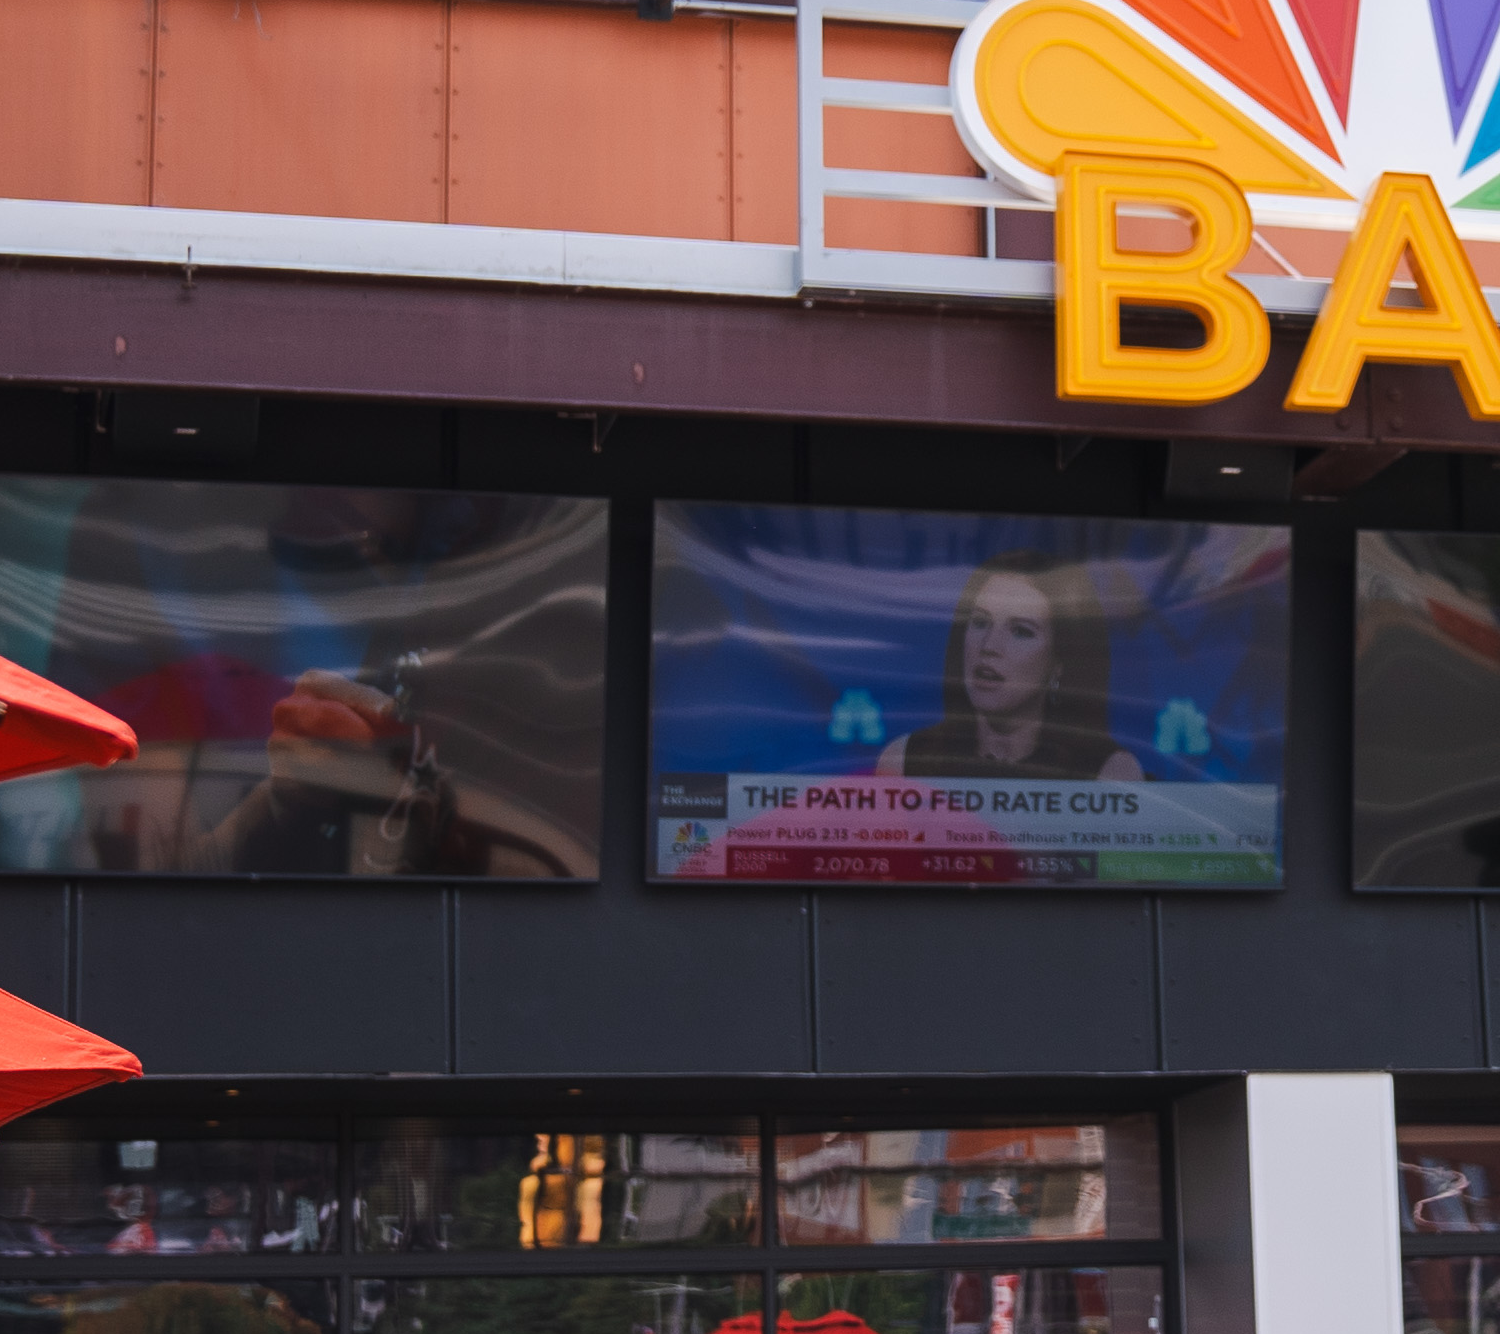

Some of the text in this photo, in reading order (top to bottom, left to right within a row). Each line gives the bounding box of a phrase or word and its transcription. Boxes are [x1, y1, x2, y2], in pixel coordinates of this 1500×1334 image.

[743, 785, 1140, 814] THE PATH TO FED RATE CUTS
[671, 843, 713, 855] CNBC
[733, 849, 789, 862] RUSSELL
[813, 856, 890, 874] 2,070.78
